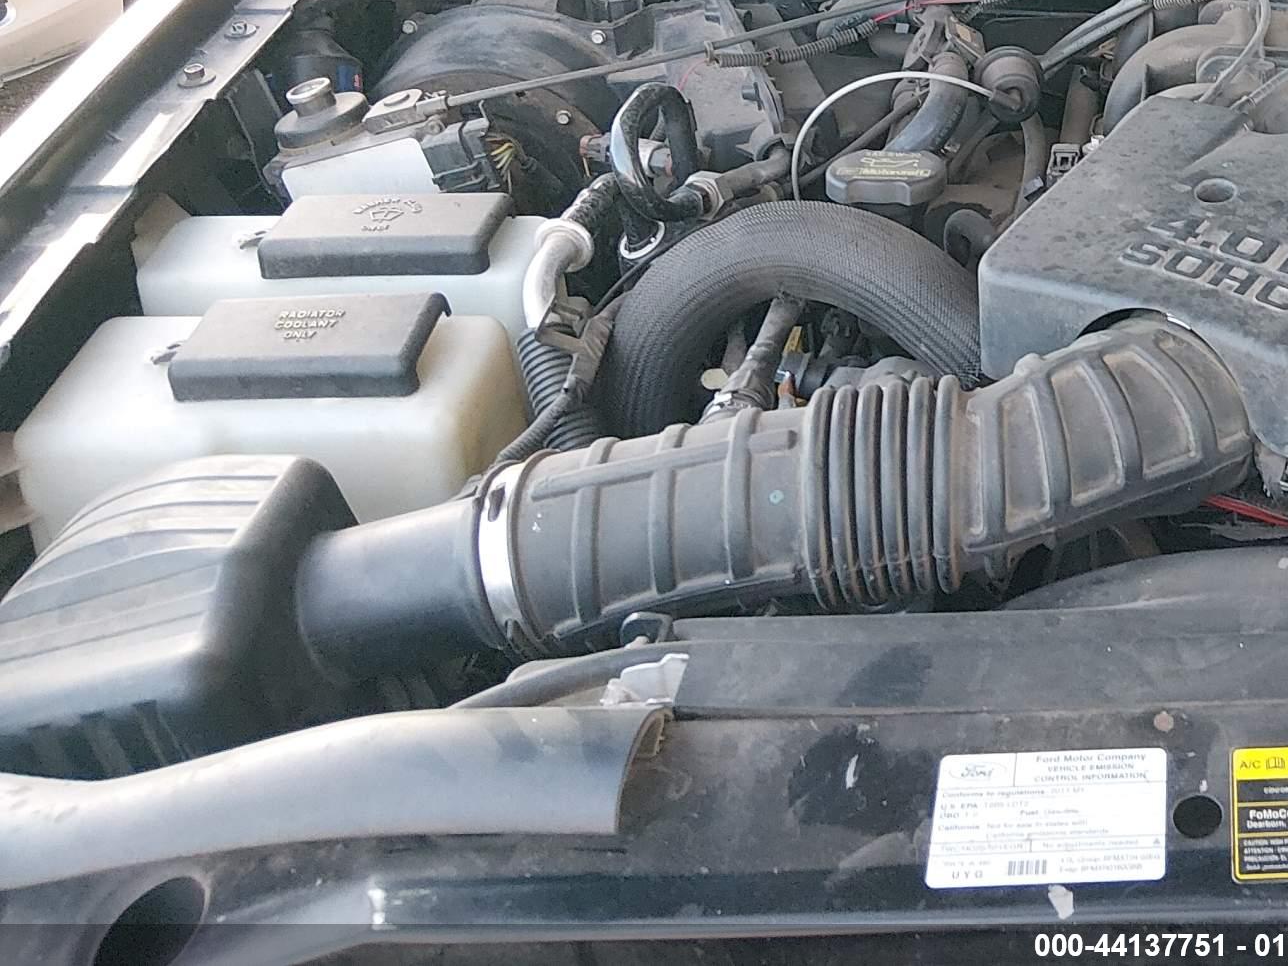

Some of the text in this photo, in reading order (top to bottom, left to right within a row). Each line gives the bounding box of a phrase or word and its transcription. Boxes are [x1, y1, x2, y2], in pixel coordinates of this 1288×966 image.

[279, 309, 346, 320] RADIATOR
[274, 320, 338, 330] COOLANT
[284, 330, 317, 339] ONLY
[1036, 752, 1146, 763] Ford Motor Company
[1240, 760, 1261, 769] A/C
[1247, 818, 1287, 829] Dearborn,
